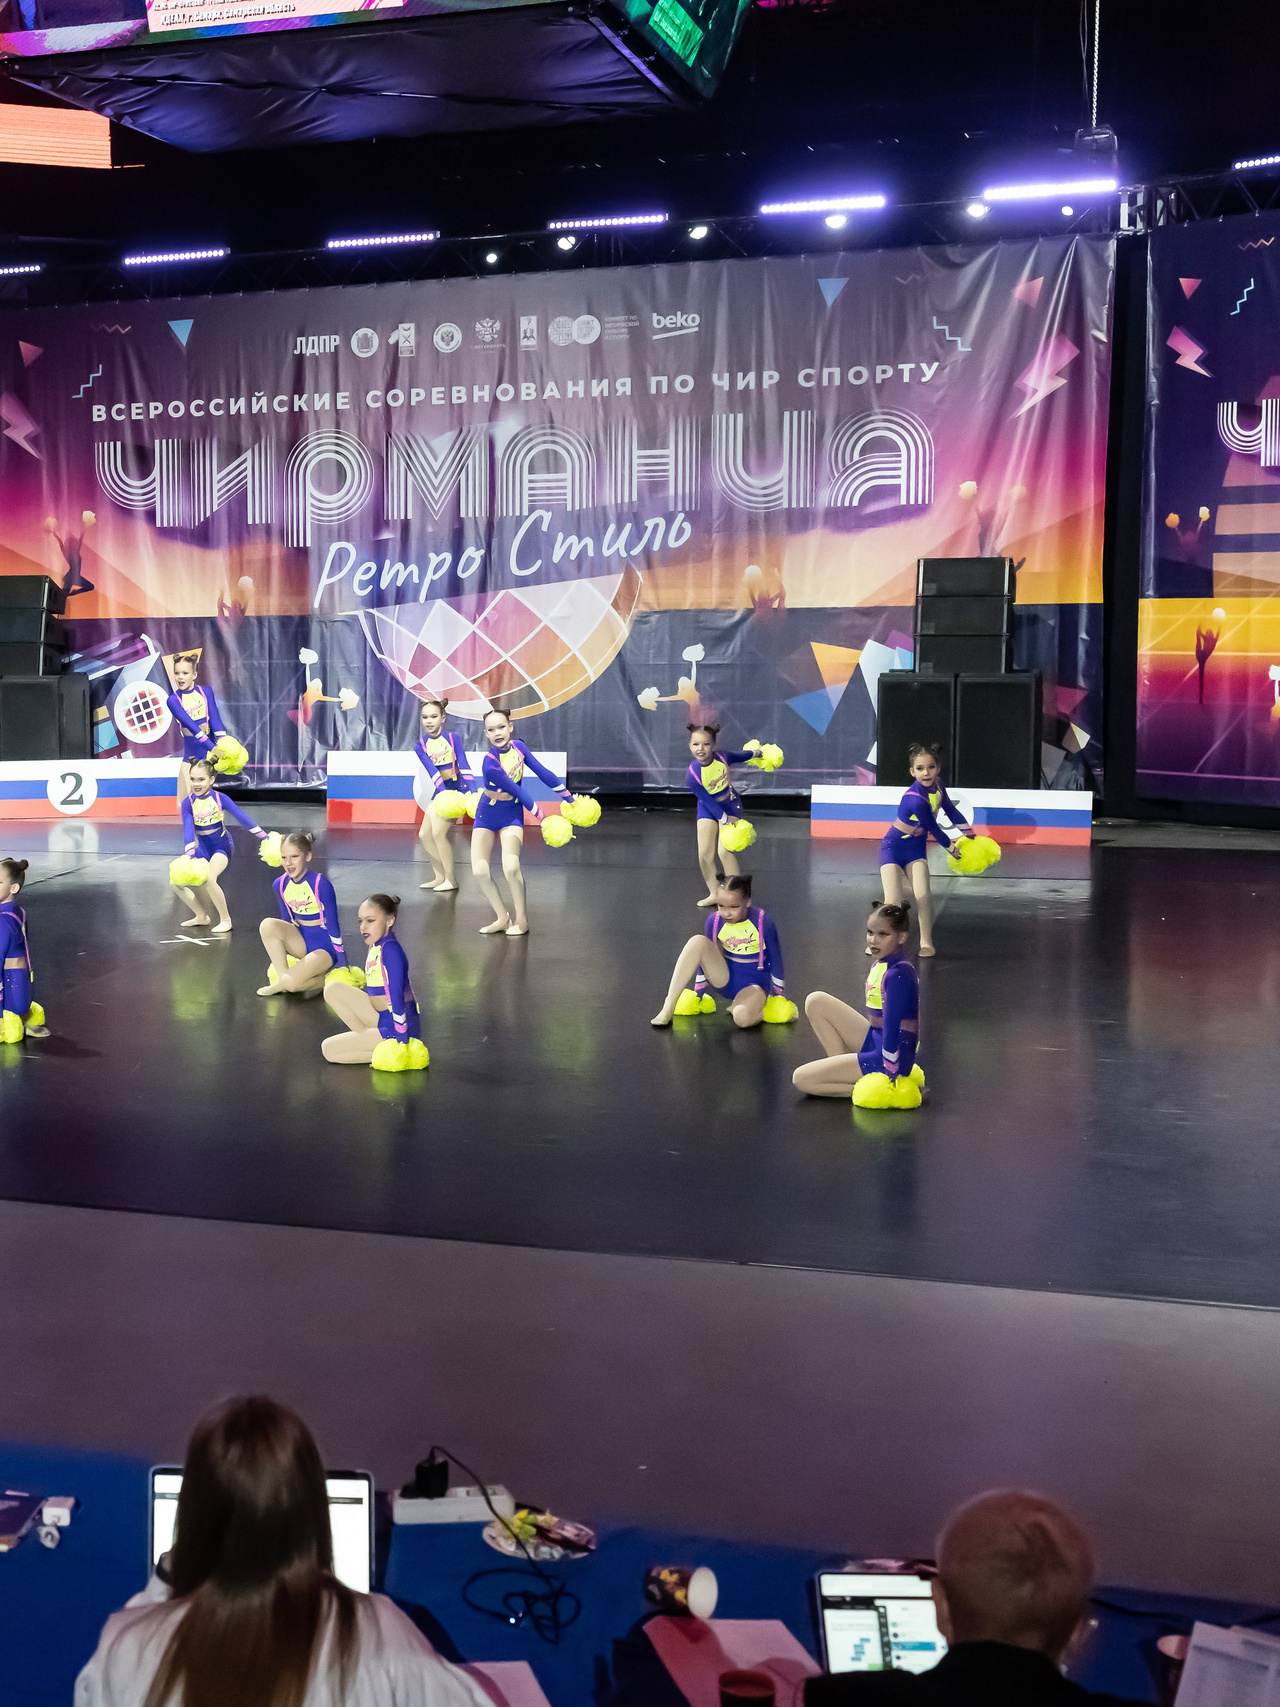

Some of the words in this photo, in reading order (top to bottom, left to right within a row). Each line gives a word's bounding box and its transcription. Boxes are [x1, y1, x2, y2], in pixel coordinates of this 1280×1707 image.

[652, 311, 701, 329] beko
[293, 334, 340, 357] ЛДПР
[92, 391, 351, 422] ВСЕРОССИЙСКИЕ
[366, 377, 633, 408] СОРЕВНОВАНИЯ
[650, 374, 695, 395] ПО
[712, 370, 780, 391] ЧИР
[798, 362, 940, 388] СПОРТУ
[313, 541, 486, 608] Ретро
[509, 509, 692, 577] Стиль
[60, 772, 84, 805] 2
